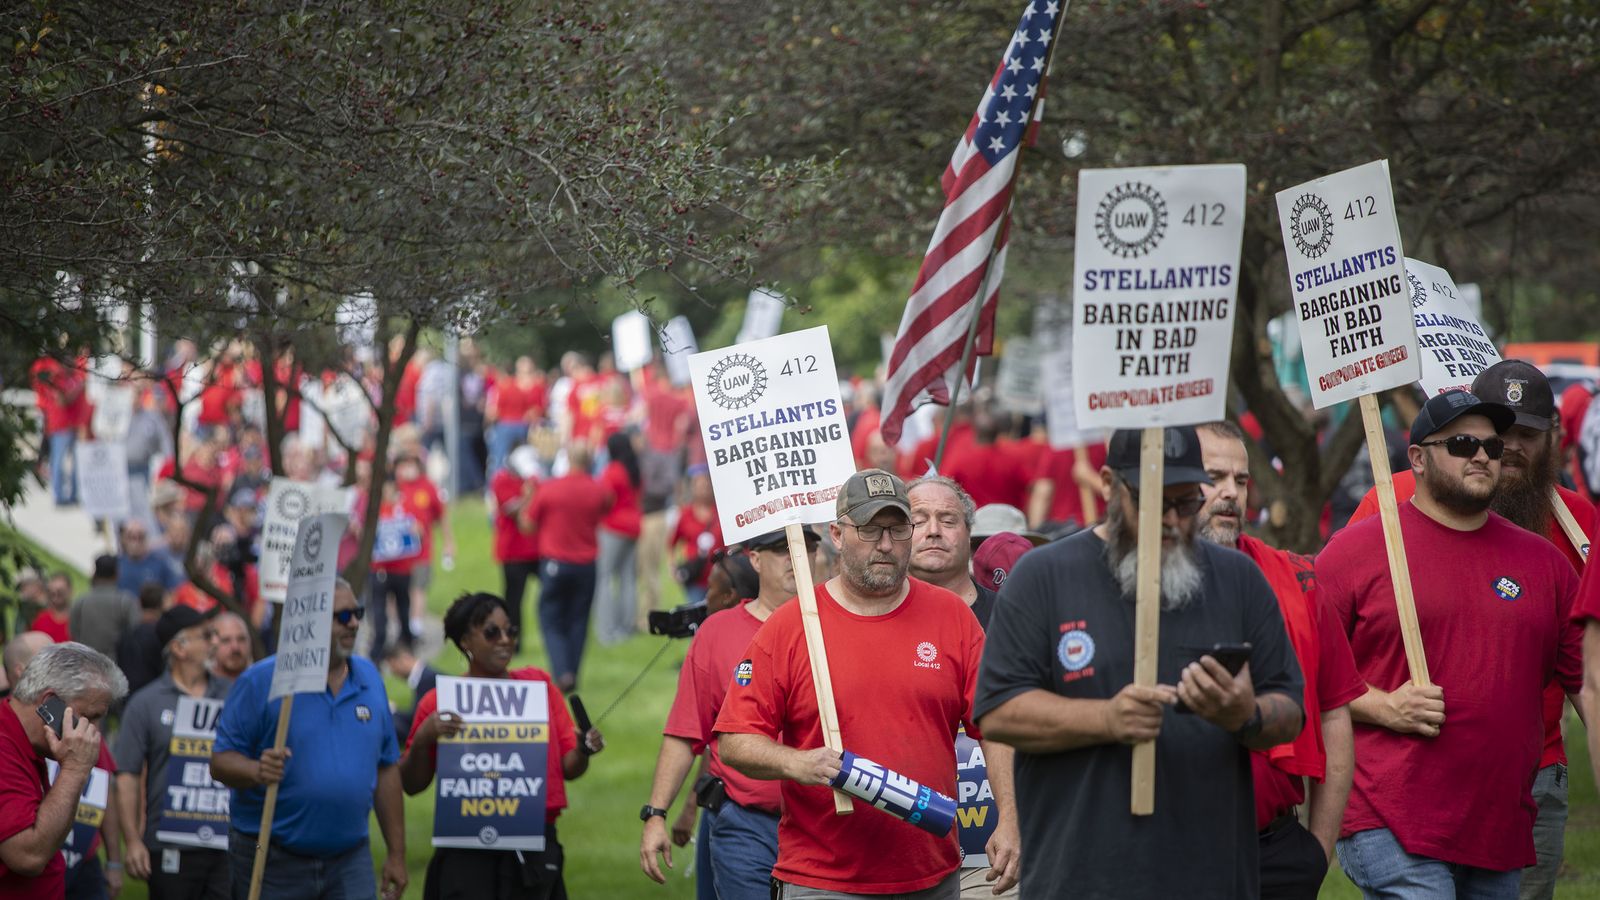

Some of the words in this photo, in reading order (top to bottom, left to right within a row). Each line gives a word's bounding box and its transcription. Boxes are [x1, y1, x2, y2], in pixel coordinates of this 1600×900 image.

[1114, 211, 1149, 229] UAW
[1182, 202, 1226, 227] 412
[1343, 195, 1377, 221] 412
[1301, 216, 1321, 236] UAW
[1084, 264, 1232, 291] STELLANTIS
[1295, 245, 1396, 292] STELLANTIS
[1299, 274, 1401, 322] BARGAINING
[1432, 281, 1456, 300] 412
[1083, 298, 1228, 325] BARGAINING
[1323, 315, 1340, 337] IN
[1343, 303, 1382, 331] BAD
[1414, 312, 1484, 337] ELLANTIS
[1115, 329, 1142, 350] IN
[1153, 327, 1197, 350] BAD
[1329, 326, 1384, 358] FAITH
[1418, 333, 1497, 357] ARGAINING
[780, 354, 818, 377] 412
[1119, 353, 1190, 377] FAITH
[1319, 356, 1376, 392] CORPORATE
[1375, 344, 1409, 370] GREED
[1432, 348, 1456, 363] IN
[1456, 347, 1488, 366] BAD
[723, 373, 751, 391] UAW
[1088, 385, 1174, 411] CORPORATE
[1175, 378, 1213, 400] GREED
[708, 398, 837, 441] STELLANTIS
[713, 423, 842, 467] BARGAINING
[745, 456, 769, 478] IN
[774, 448, 817, 469] BAD
[752, 468, 817, 496] FAITH
[735, 492, 807, 528] CORPORATE
[1500, 577, 1520, 594] 97%
[913, 660, 929, 668] Local
[455, 683, 528, 717] UAW
[516, 727, 541, 739] UP
[178, 739, 208, 753] STA
[459, 752, 525, 772] COLA
[440, 778, 494, 797] FAIR
[497, 777, 543, 797] PAY
[842, 757, 885, 802] EN
[958, 779, 995, 803] PA
[168, 785, 231, 815] TIER
[460, 798, 520, 817] NOW
